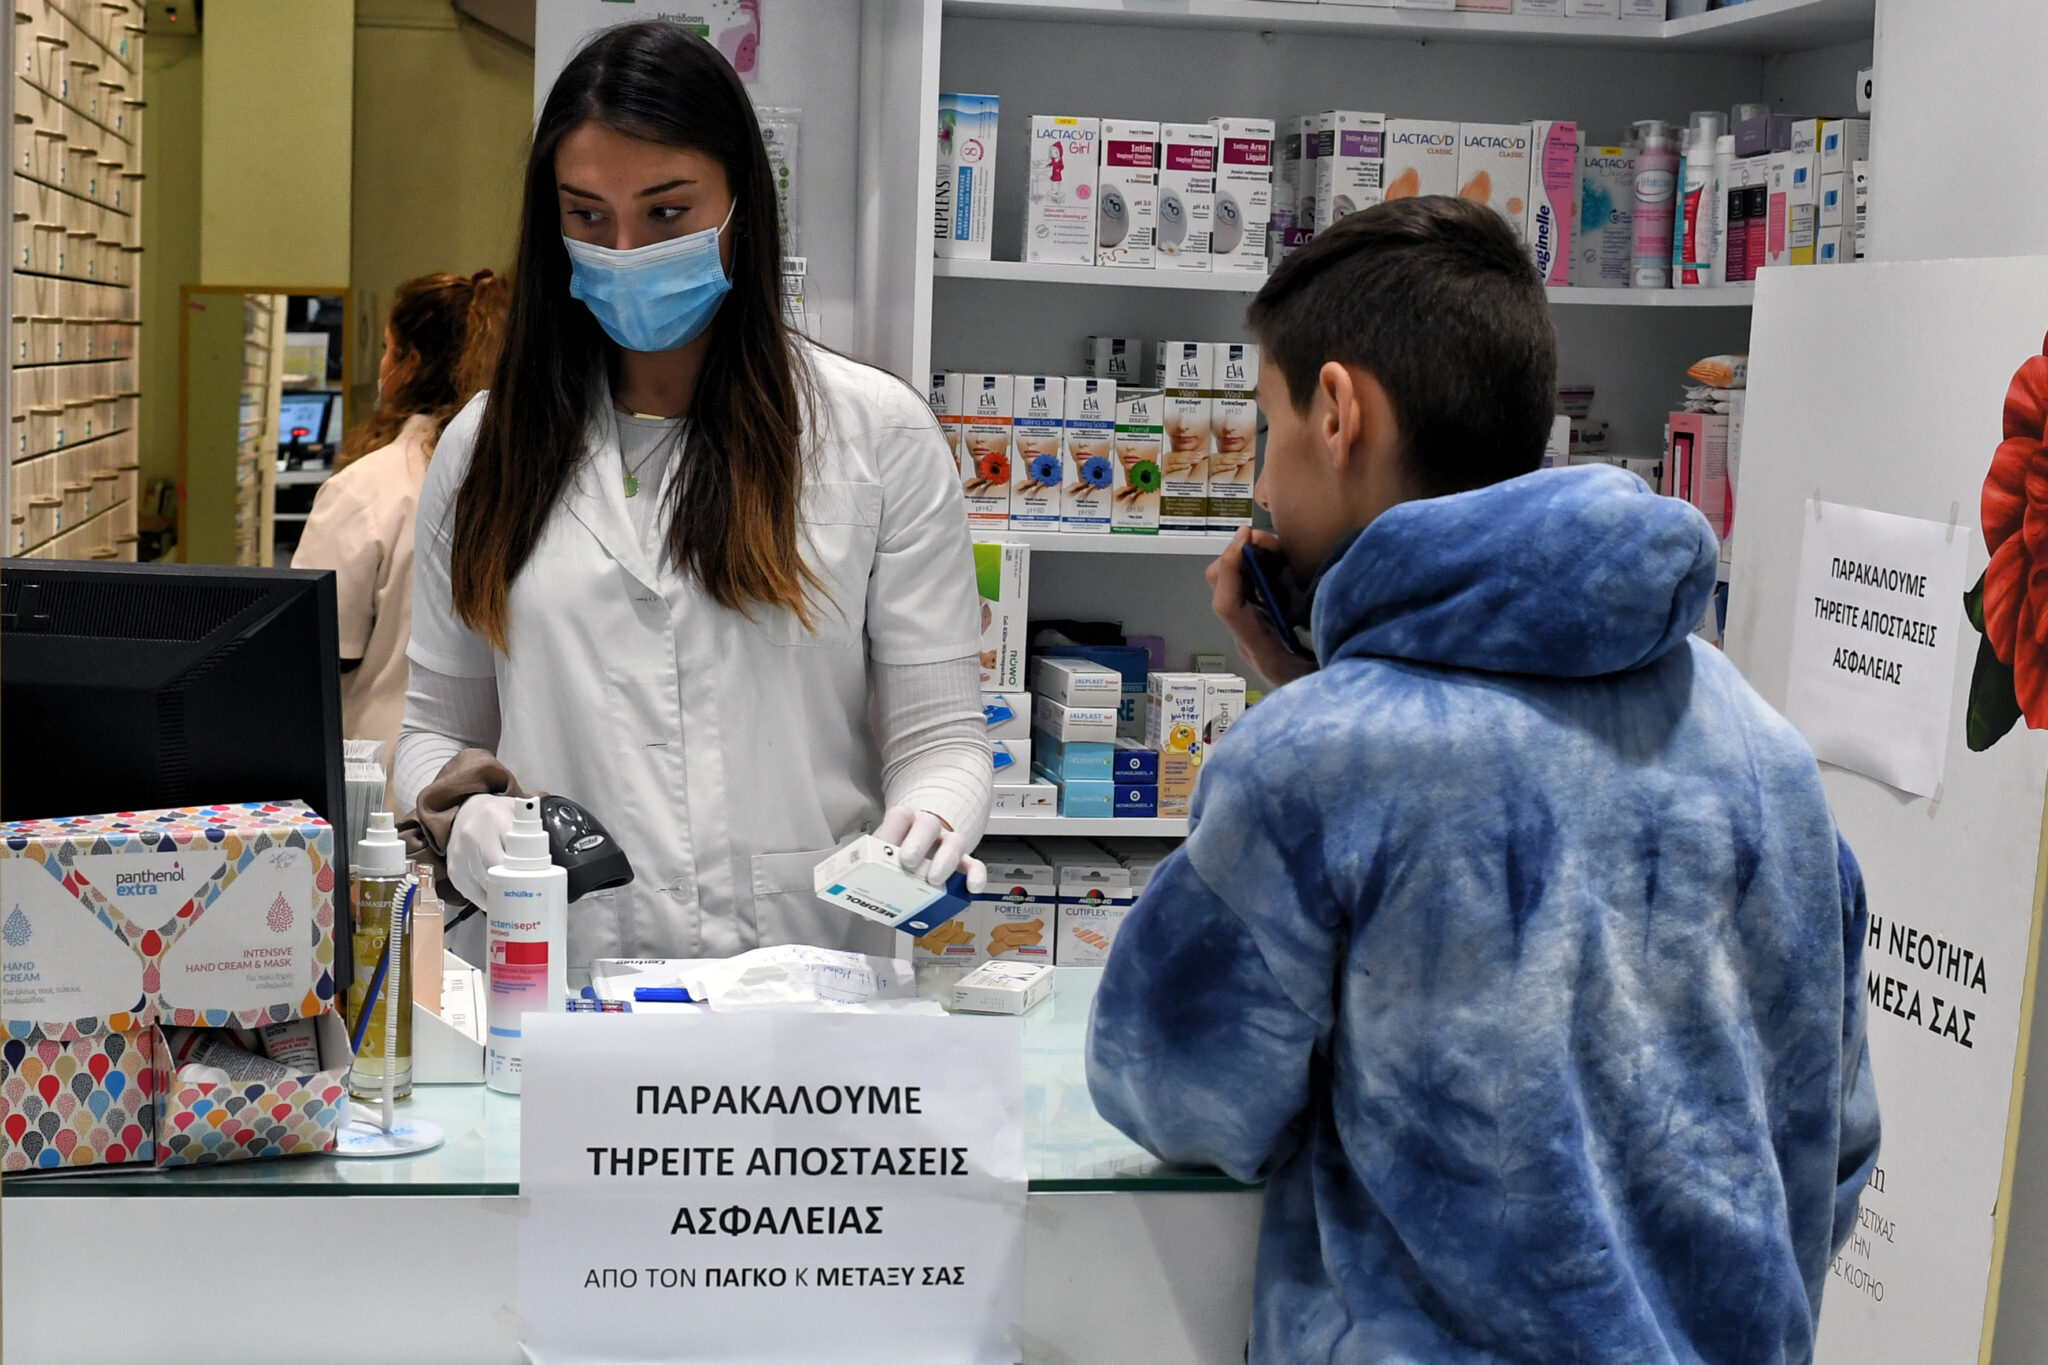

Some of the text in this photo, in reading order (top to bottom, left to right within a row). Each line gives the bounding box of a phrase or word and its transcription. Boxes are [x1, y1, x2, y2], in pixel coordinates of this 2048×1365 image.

[1036, 129, 1095, 141] LACTACYD
[1392, 132, 1454, 146] LACTACYD
[1069, 142, 1091, 154] Girl
[1131, 144, 1153, 153] Intim
[1250, 143, 1267, 151] Area
[1464, 135, 1526, 150] LACTACYD
[1190, 148, 1212, 157] Intim
[1245, 153, 1266, 163] Liquid
[1427, 148, 1453, 156] CLASSIC
[1498, 151, 1524, 159] CLASSIC
[1108, 357, 1127, 372] EVA
[1180, 361, 1198, 378] EVA
[1226, 363, 1244, 379] EVA
[930, 391, 946, 405] EVA
[980, 392, 996, 407] EVA
[1178, 389, 1199, 397] Wash
[1224, 390, 1245, 398] Wash
[1031, 394, 1047, 409] EVA
[1083, 396, 1099, 411] EVA
[1131, 400, 1147, 415] EVA
[1021, 418, 1041, 427] Baking
[1831, 557, 1927, 598] ΠΑΡΑΚΑΛΟΥΜΕ
[1814, 597, 1938, 648] ΤΗΡΕΙΤΕ ΑΠΟΣΤΑΣΕΙΣ
[1832, 647, 1903, 685] ΑΣΦΑΛΕΙΑΣ
[1175, 697, 1195, 706] first
[1180, 704, 1195, 713] aid
[1118, 699, 1135, 721] RE
[116, 867, 185, 886] panthenol
[116, 883, 158, 896] extra
[846, 893, 899, 919] MEDROL
[994, 905, 1042, 915] FORTE MED
[1065, 907, 1106, 917] CUTIFLEX
[243, 947, 293, 959] INTENSIVE
[1867, 913, 1987, 994] Η ΝΕΟΤΗΤΑ
[3, 961, 35, 972] HAND
[185, 958, 292, 973] HAND CREAM & MASK
[3, 972, 40, 983] CREAM
[1928, 995, 1977, 1049] ΣΑΣ
[266, 1027, 288, 1038] extra
[636, 1085, 922, 1115] ΠΑΡΑΚΑΛΟΥΜΕ
[586, 1147, 969, 1176] ΤΗΡΕΙΤΕ ΑΠΟΣΤΑΣΕΙΣ
[670, 1205, 884, 1237] ΑΣΦΑΛΕΙΑΣ
[1857, 1205, 1896, 1244] ΑΣΤΙΧΑΣ
[584, 1266, 966, 1289] ΑΠΟ ΤΟΝ ΠΑΓΚΟ Κ ΜΕΤΑΞΥ ΣΑΣ
